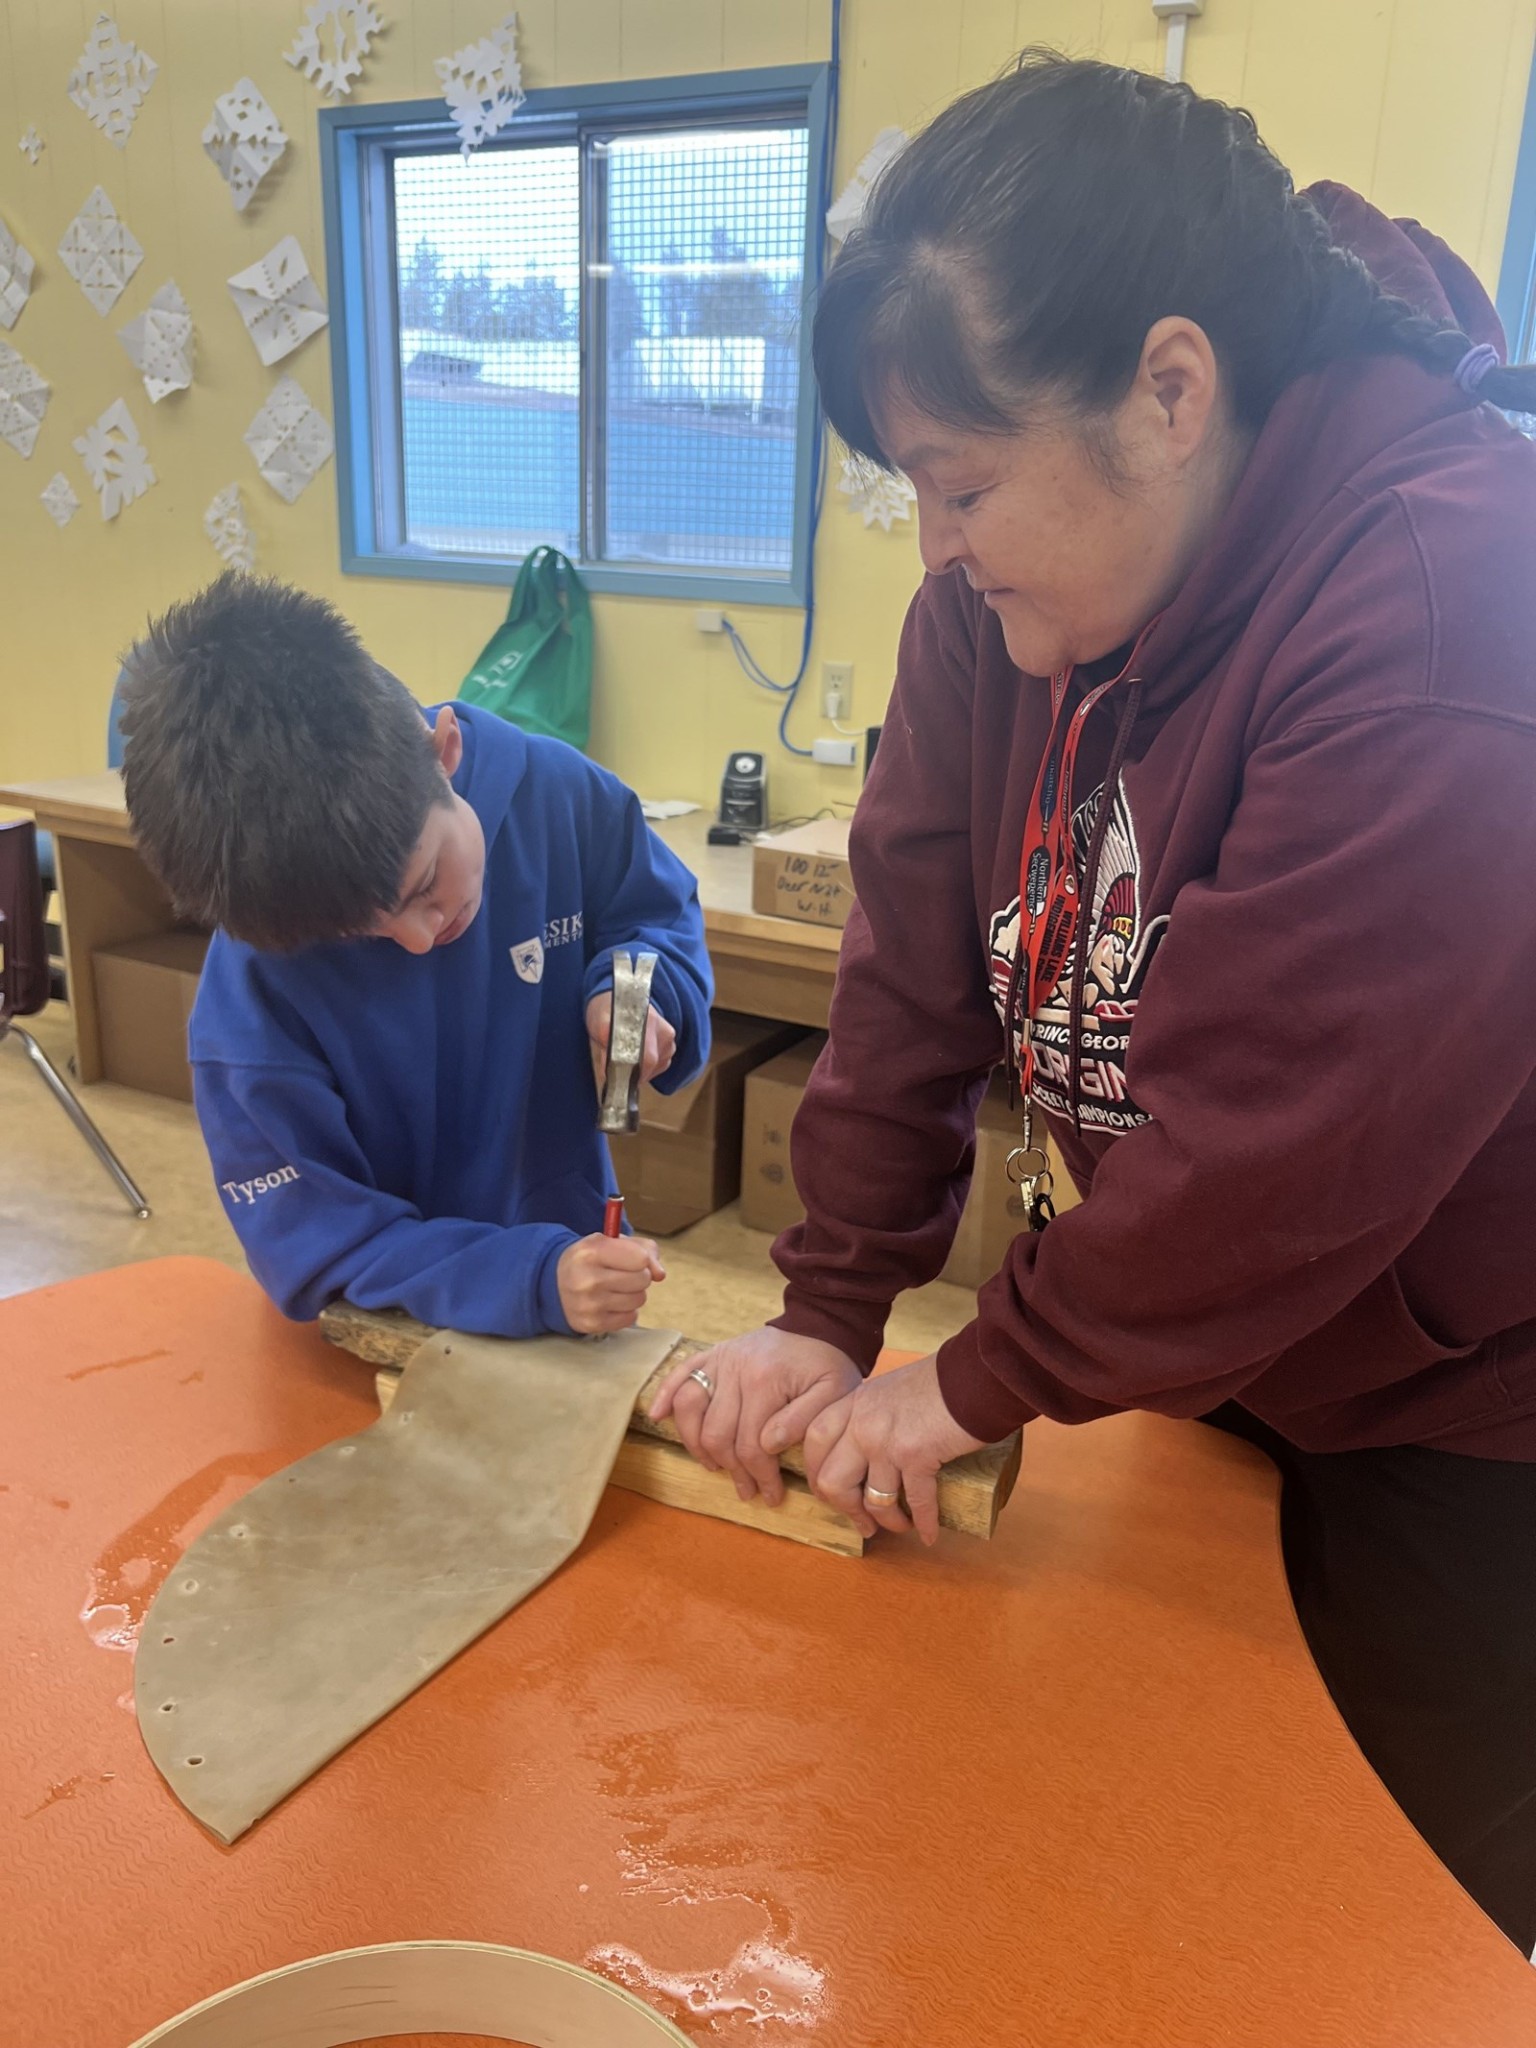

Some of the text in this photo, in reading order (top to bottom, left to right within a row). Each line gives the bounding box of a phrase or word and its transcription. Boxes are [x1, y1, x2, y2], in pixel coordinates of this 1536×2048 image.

[784, 855, 809, 876] 100
[1028, 852, 1042, 909] Secwepemc
[1036, 858, 1050, 903] Northern
[1040, 910, 1074, 983] WILLIAMS LAKE
[1031, 1022, 1071, 1046] PRINC
[222, 1165, 301, 1205] Tyson
